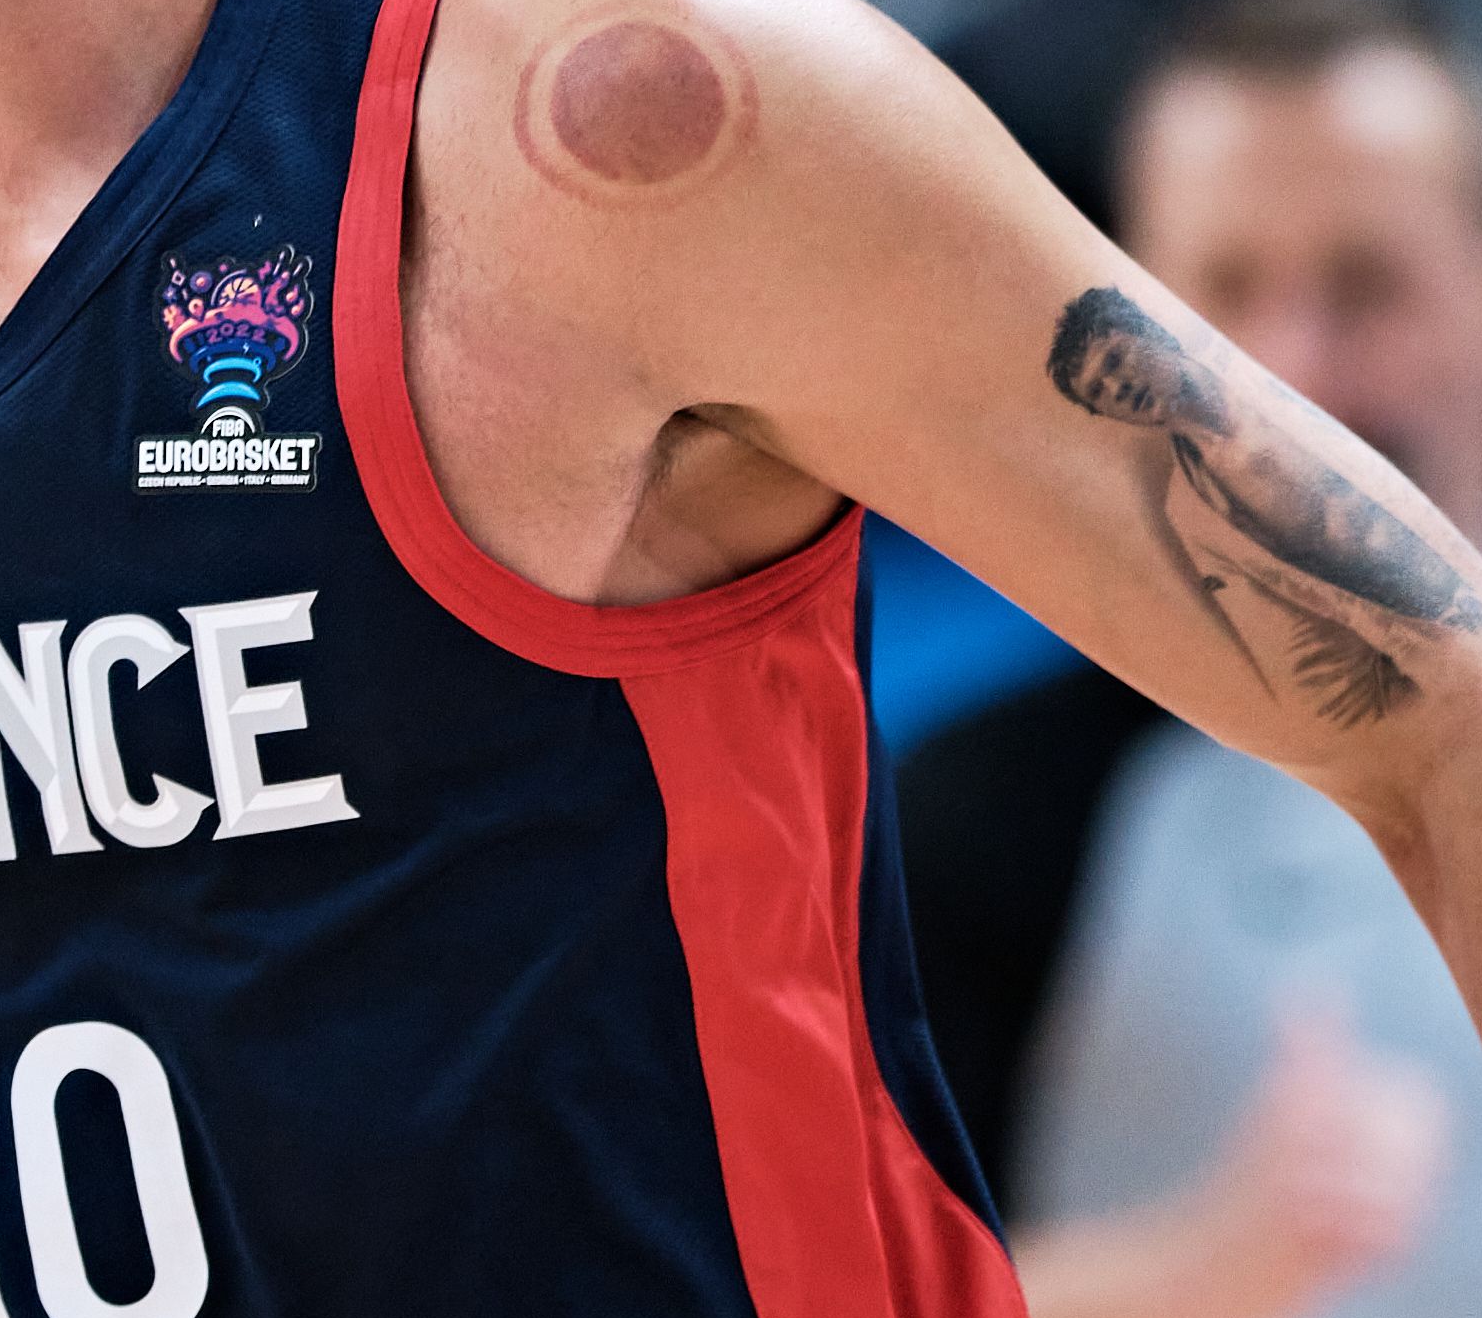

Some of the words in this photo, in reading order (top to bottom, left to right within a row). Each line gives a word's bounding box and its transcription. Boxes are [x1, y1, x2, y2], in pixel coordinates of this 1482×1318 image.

[207, 322, 266, 343] 2022
[212, 418, 245, 438] FIBA
[138, 438, 316, 473] EUROBASKET
